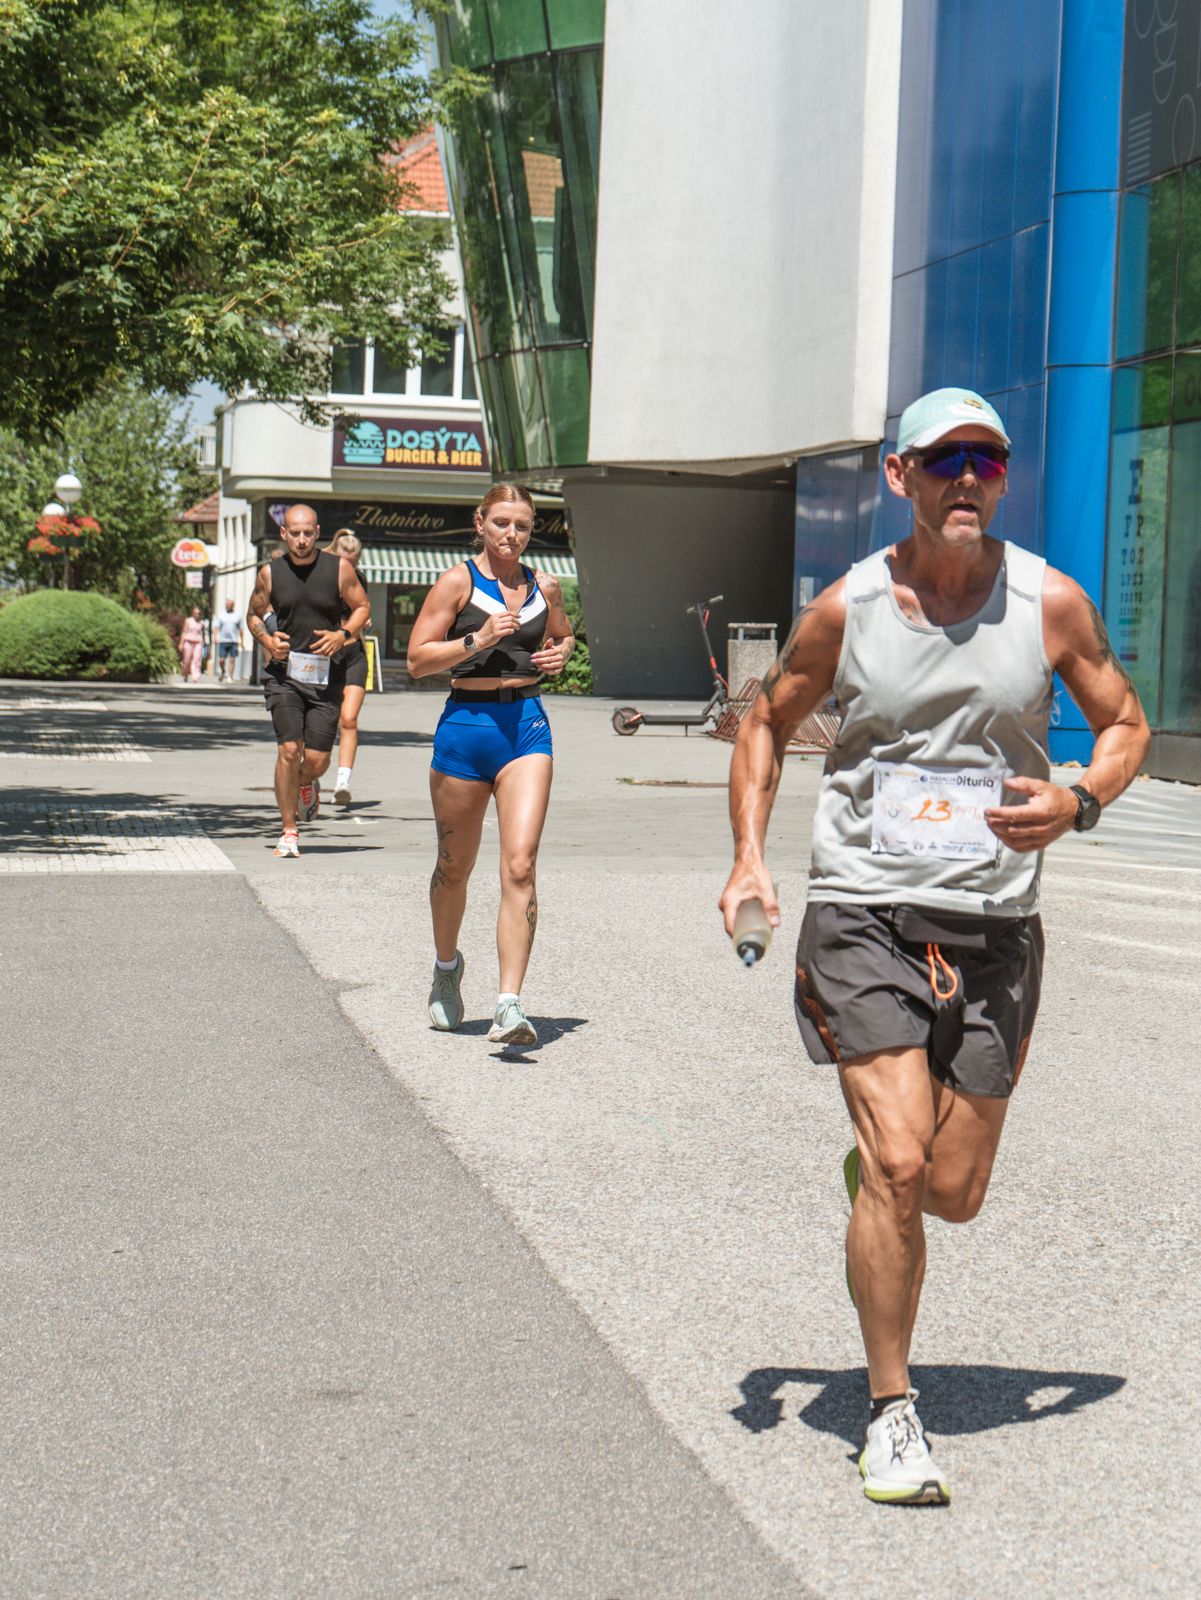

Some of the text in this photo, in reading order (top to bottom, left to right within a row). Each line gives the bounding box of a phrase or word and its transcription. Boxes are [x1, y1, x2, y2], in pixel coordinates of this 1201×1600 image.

[385, 426, 482, 452] DOSÝTA
[385, 448, 482, 466] BURGER & BEER
